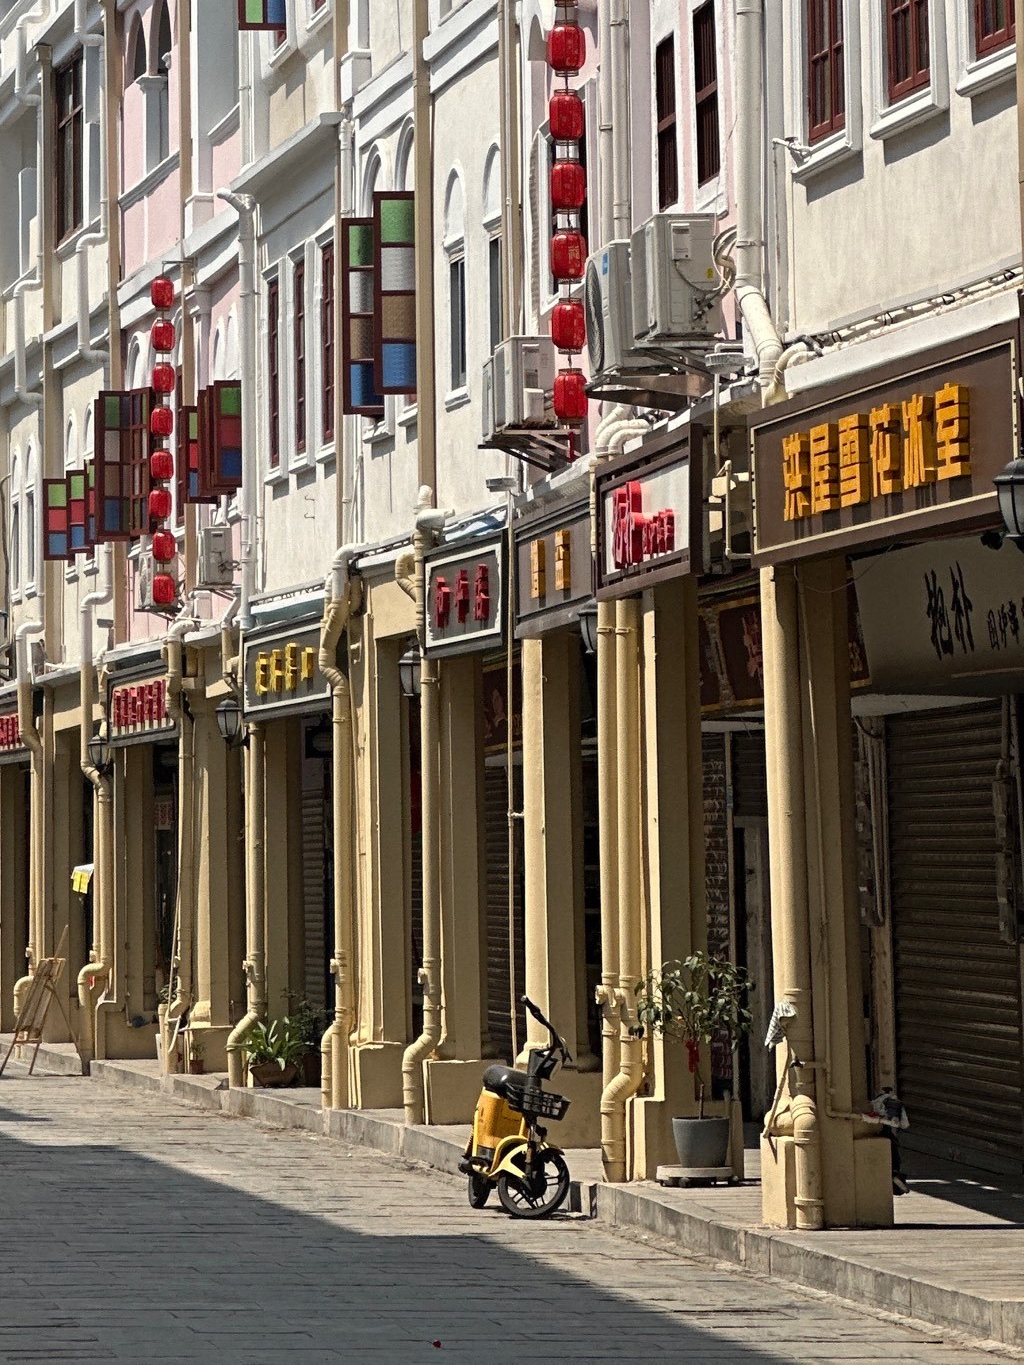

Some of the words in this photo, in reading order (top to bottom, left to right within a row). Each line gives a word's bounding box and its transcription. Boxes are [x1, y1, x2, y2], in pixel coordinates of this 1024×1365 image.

[782, 382, 971, 522] 洪屋雪花冰室
